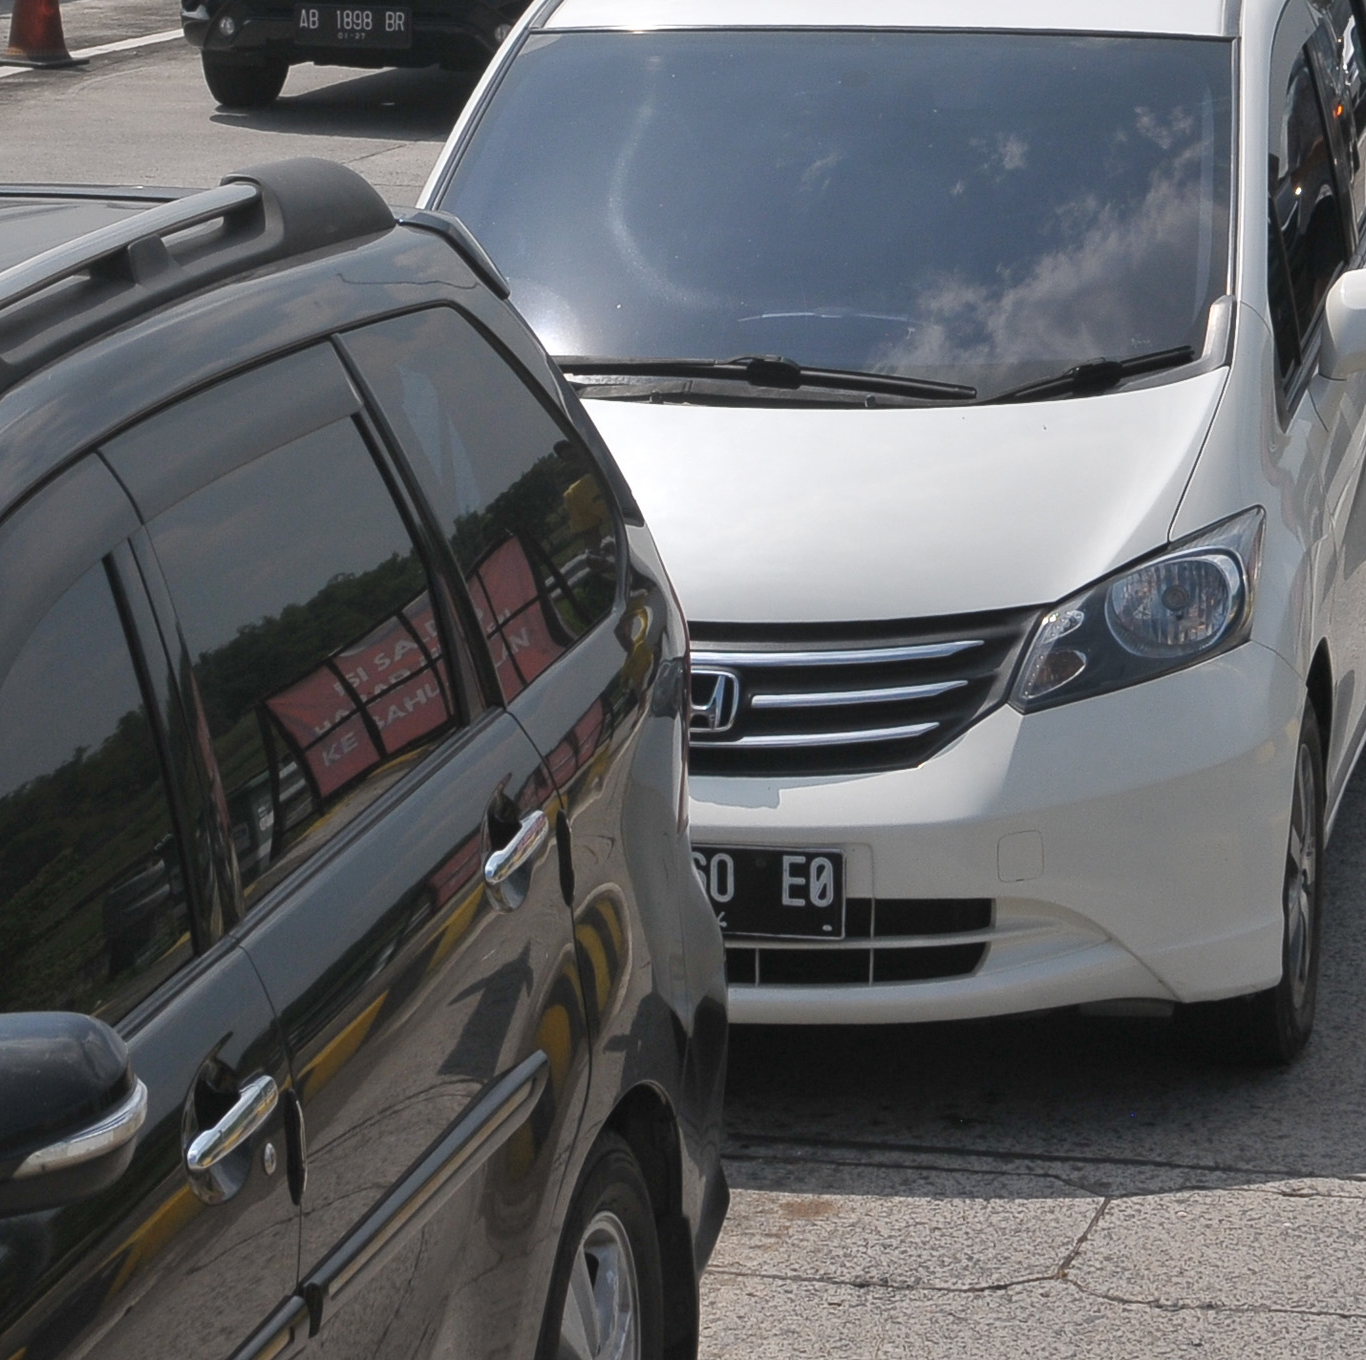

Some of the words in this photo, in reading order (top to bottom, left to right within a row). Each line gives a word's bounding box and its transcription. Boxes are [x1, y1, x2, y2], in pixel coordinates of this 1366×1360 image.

[299, 9, 319, 29] AB
[336, 10, 373, 31] 1898
[385, 11, 405, 32] BR
